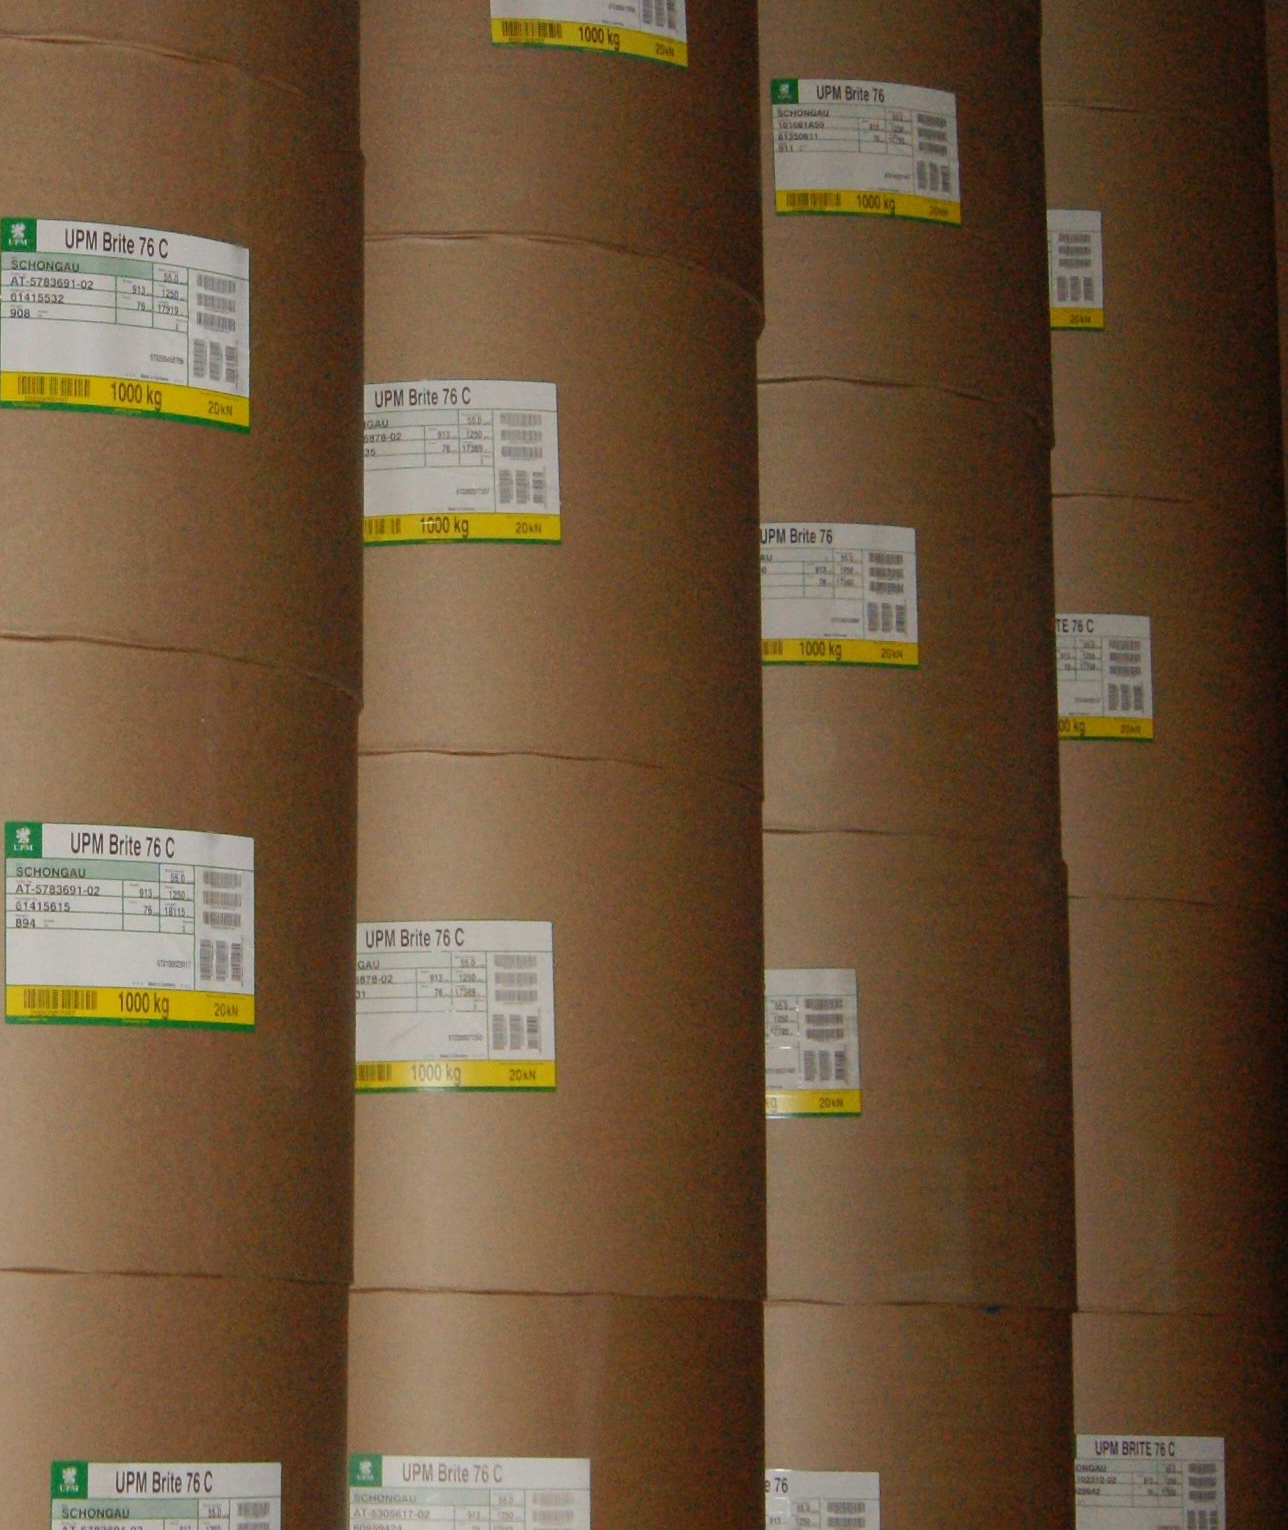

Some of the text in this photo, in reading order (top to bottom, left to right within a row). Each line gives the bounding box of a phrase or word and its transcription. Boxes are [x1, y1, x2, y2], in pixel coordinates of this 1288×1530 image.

[817, 86, 885, 102] UPM Brite 76
[65, 229, 168, 258] UPM Brite 76 C
[12, 260, 79, 271] SCHONGAU
[10, 293, 64, 303] 61415532
[10, 309, 30, 318] 908
[111, 383, 162, 410] 1000 kg
[375, 387, 471, 408] UPM Brite 76 C
[760, 528, 832, 544] UPM Brite 76
[71, 833, 175, 857] UPM Brite 76 C
[16, 867, 86, 878] SCHONGAU
[16, 902, 70, 912] 61415615
[15, 918, 35, 928] 894
[366, 928, 464, 948] UPM Brite 76 C
[118, 992, 169, 1019] 1000 kg
[412, 1064, 461, 1086] 1000 kg
[1095, 1441, 1175, 1456] UPM BRITE 76 C
[116, 1471, 213, 1494] UPM Brite 76 C
[775, 1478, 788, 1493] 76
[62, 1508, 130, 1519] SCHONGAU
